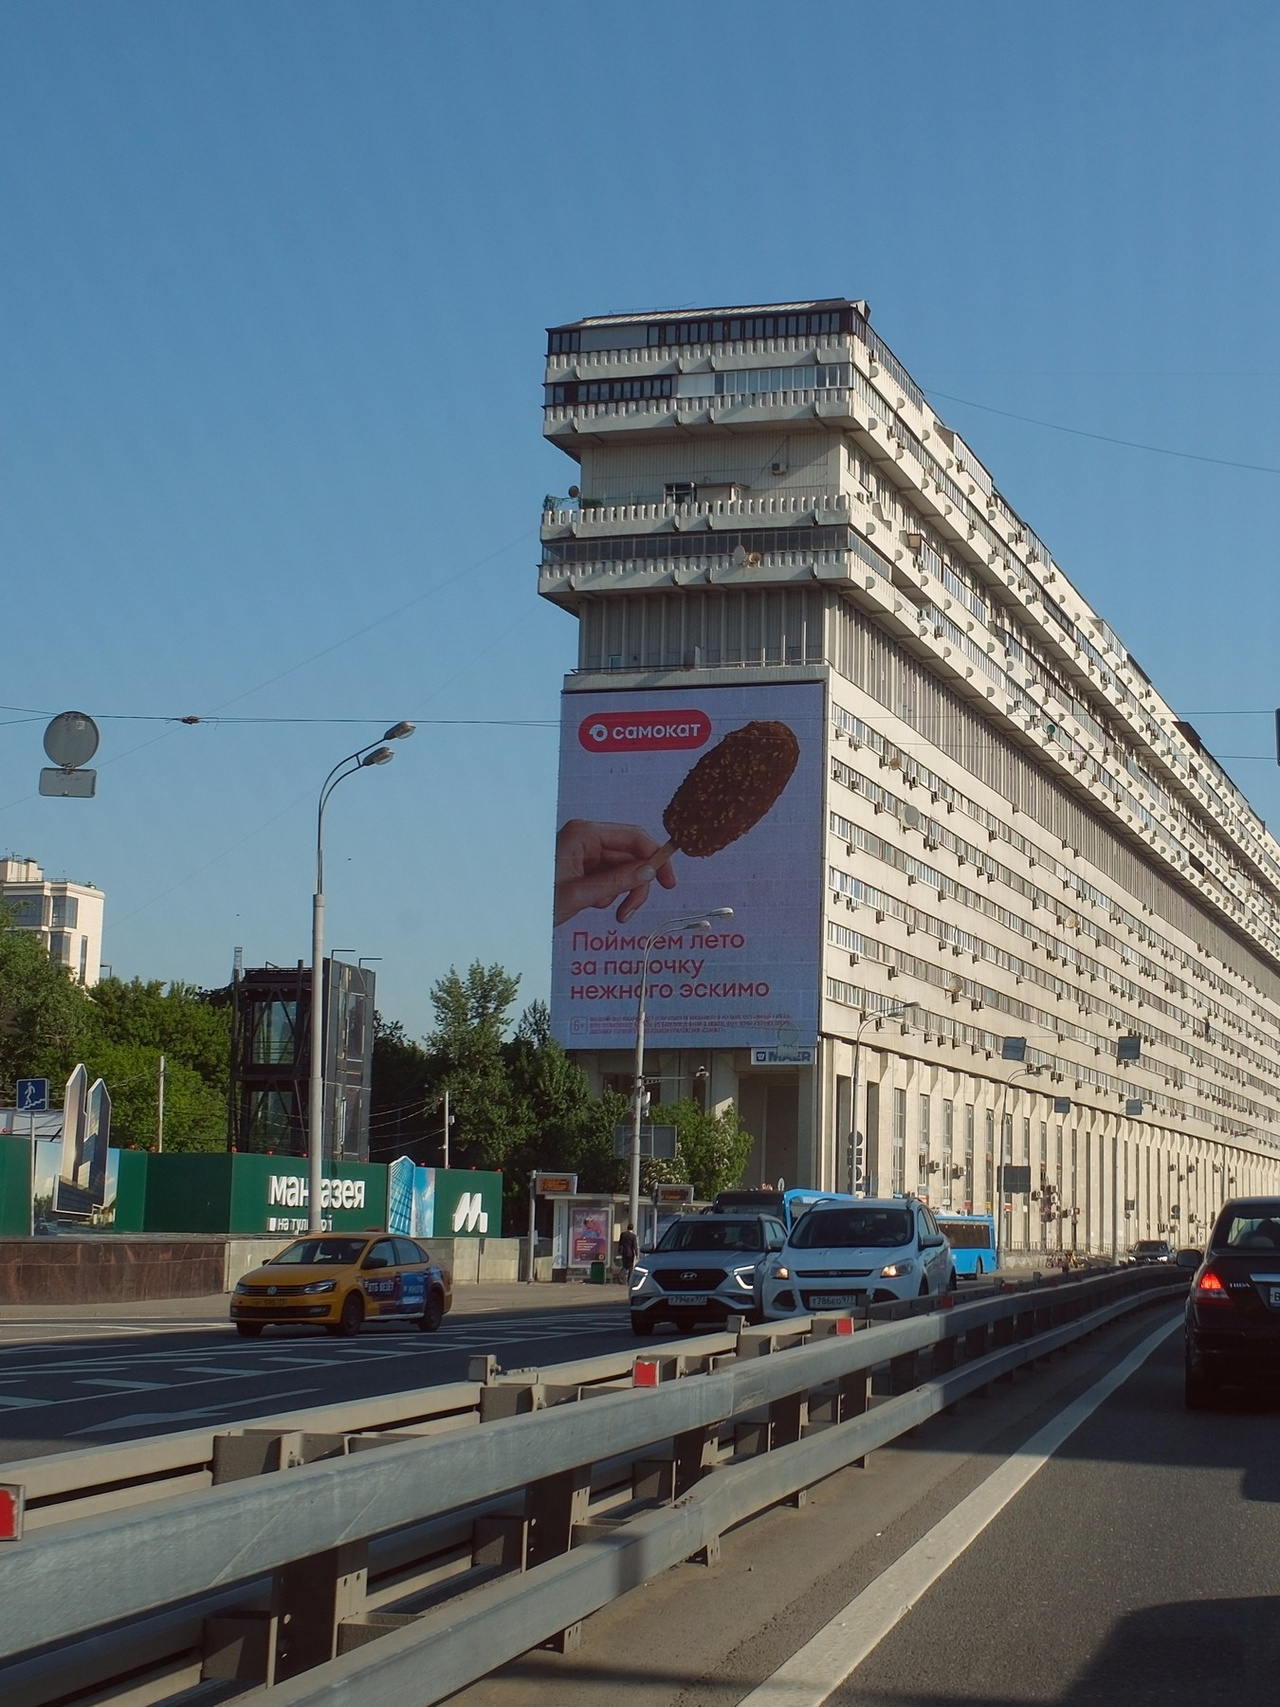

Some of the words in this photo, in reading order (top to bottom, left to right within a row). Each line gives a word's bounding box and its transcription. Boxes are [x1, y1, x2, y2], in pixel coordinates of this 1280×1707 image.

[612, 724, 701, 740] самокат
[572, 930, 683, 951] Поймаем
[689, 933, 745, 949] лето
[571, 960, 597, 976] за
[604, 959, 705, 979] палочку
[571, 983, 673, 1000] нежного
[679, 982, 770, 999] эскимо
[268, 1176, 365, 1209] маназея
[277, 1217, 289, 1231] на
